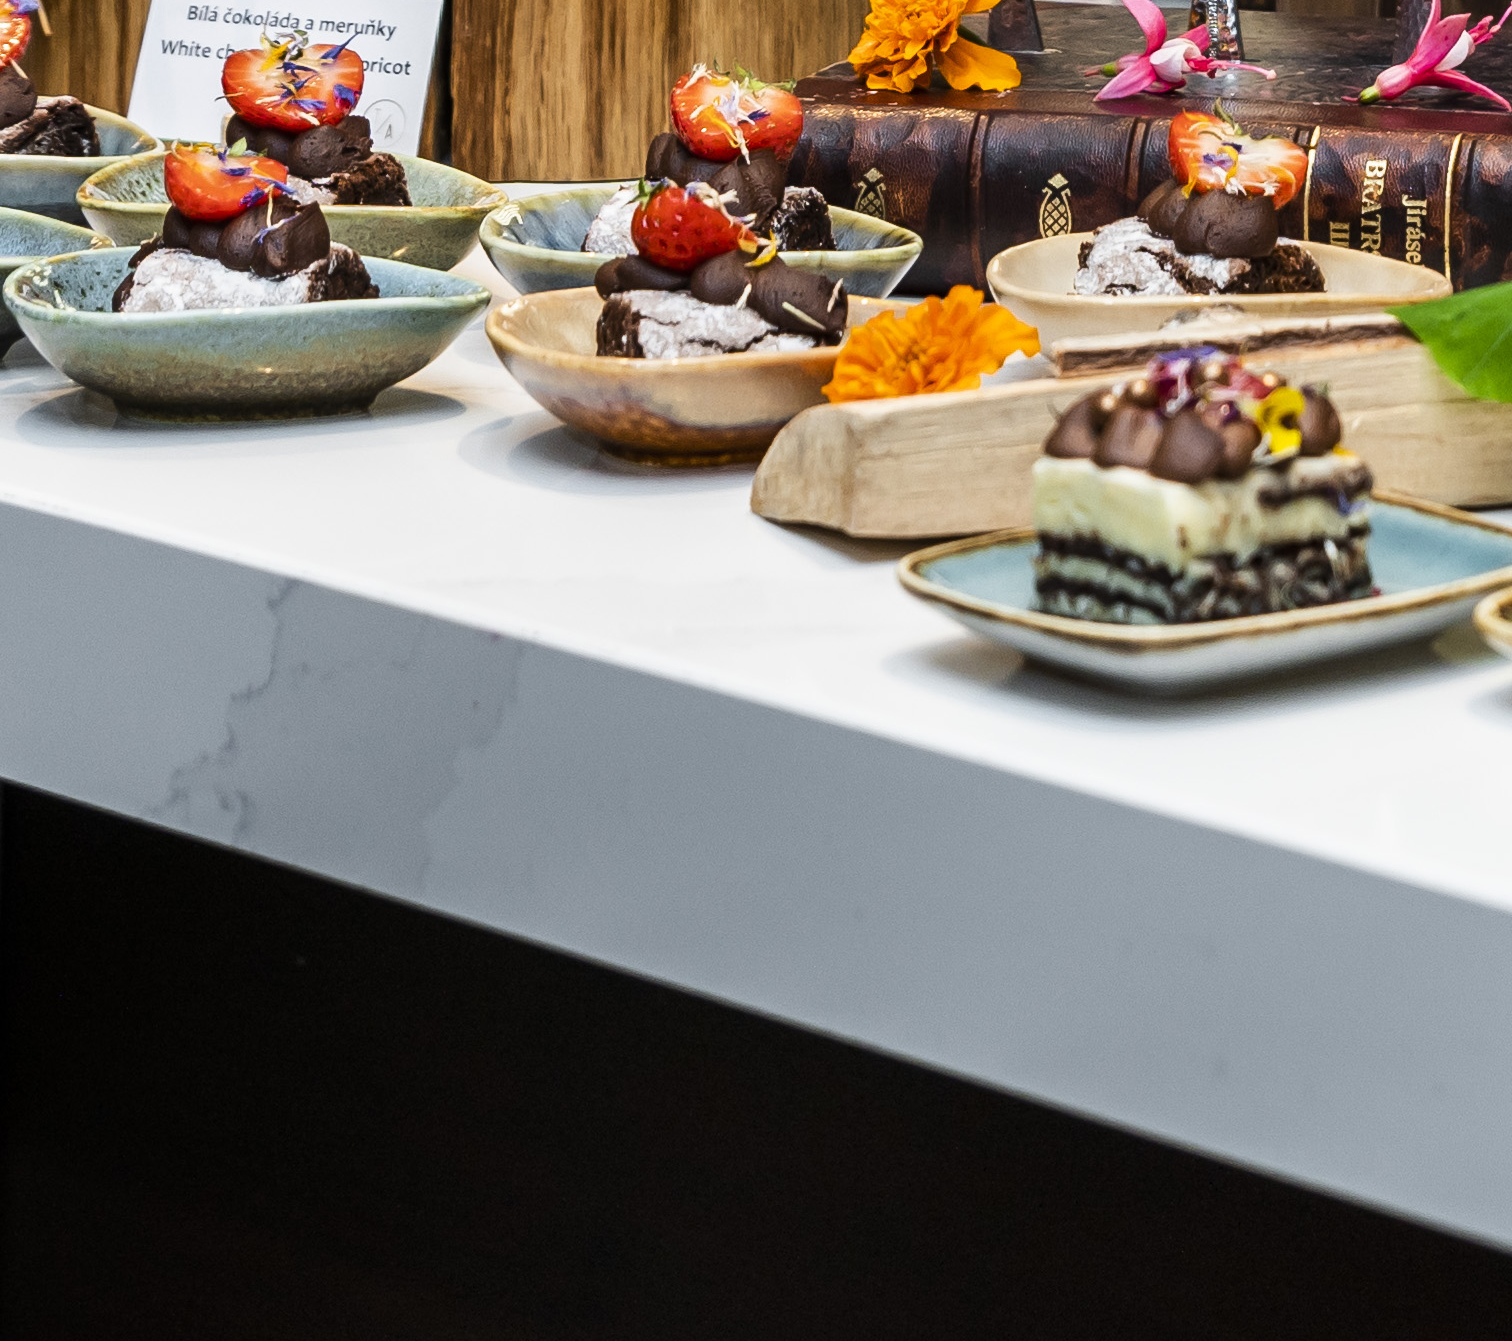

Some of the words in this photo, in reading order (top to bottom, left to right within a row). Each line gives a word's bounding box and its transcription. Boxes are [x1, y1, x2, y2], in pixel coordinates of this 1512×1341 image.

[161, 39, 211, 58] White
[187, 5, 219, 22] Bílá
[223, 7, 300, 30] čokoláda
[305, 18, 314, 30] a
[319, 19, 397, 41] meruňky
[1360, 159, 1388, 256] BRATR
[1402, 193, 1428, 264] Jiráse
